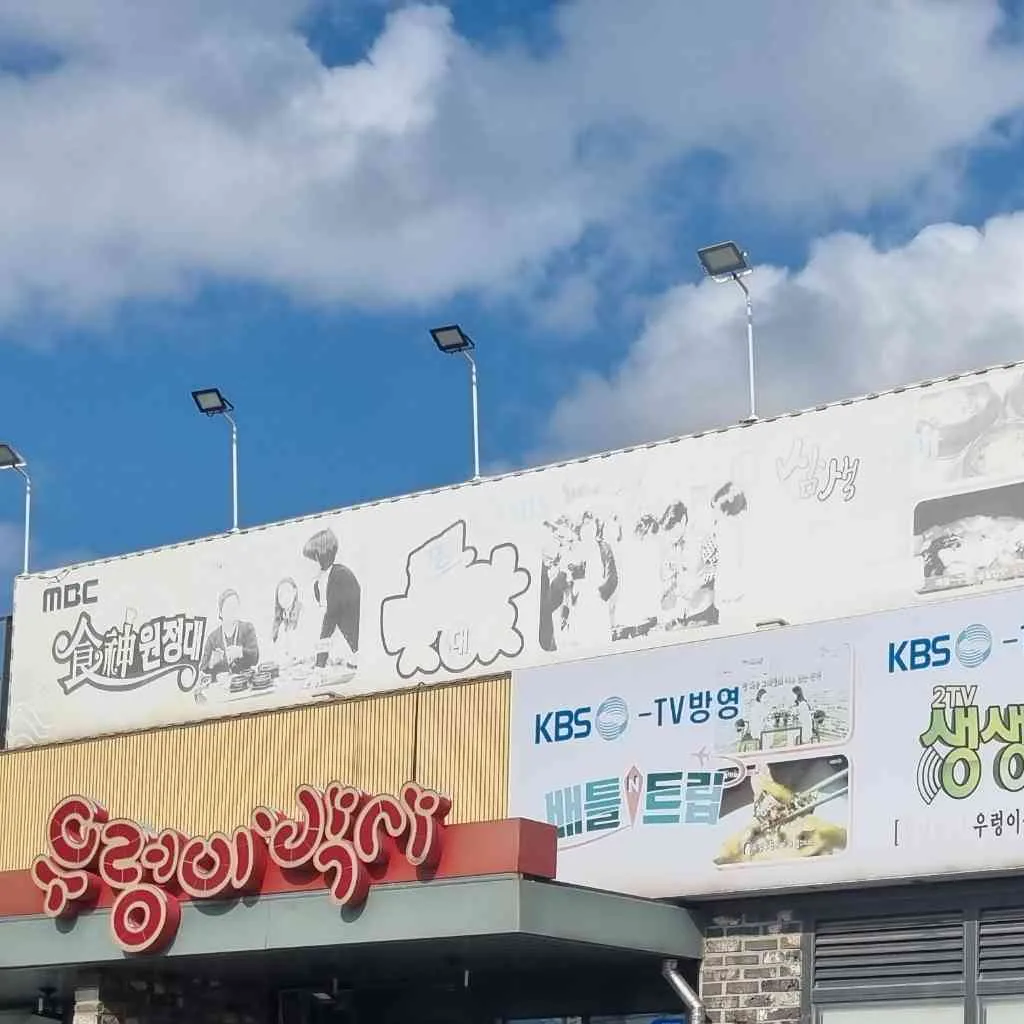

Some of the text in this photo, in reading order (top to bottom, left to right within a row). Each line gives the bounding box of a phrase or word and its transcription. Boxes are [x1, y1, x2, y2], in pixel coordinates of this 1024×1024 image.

[42, 578, 99, 613] MBC
[887, 634, 951, 673] KBS
[931, 684, 978, 707] 2TV
[534, 706, 592, 745] KBS
[31, 779, 452, 953] 우렁이박사
